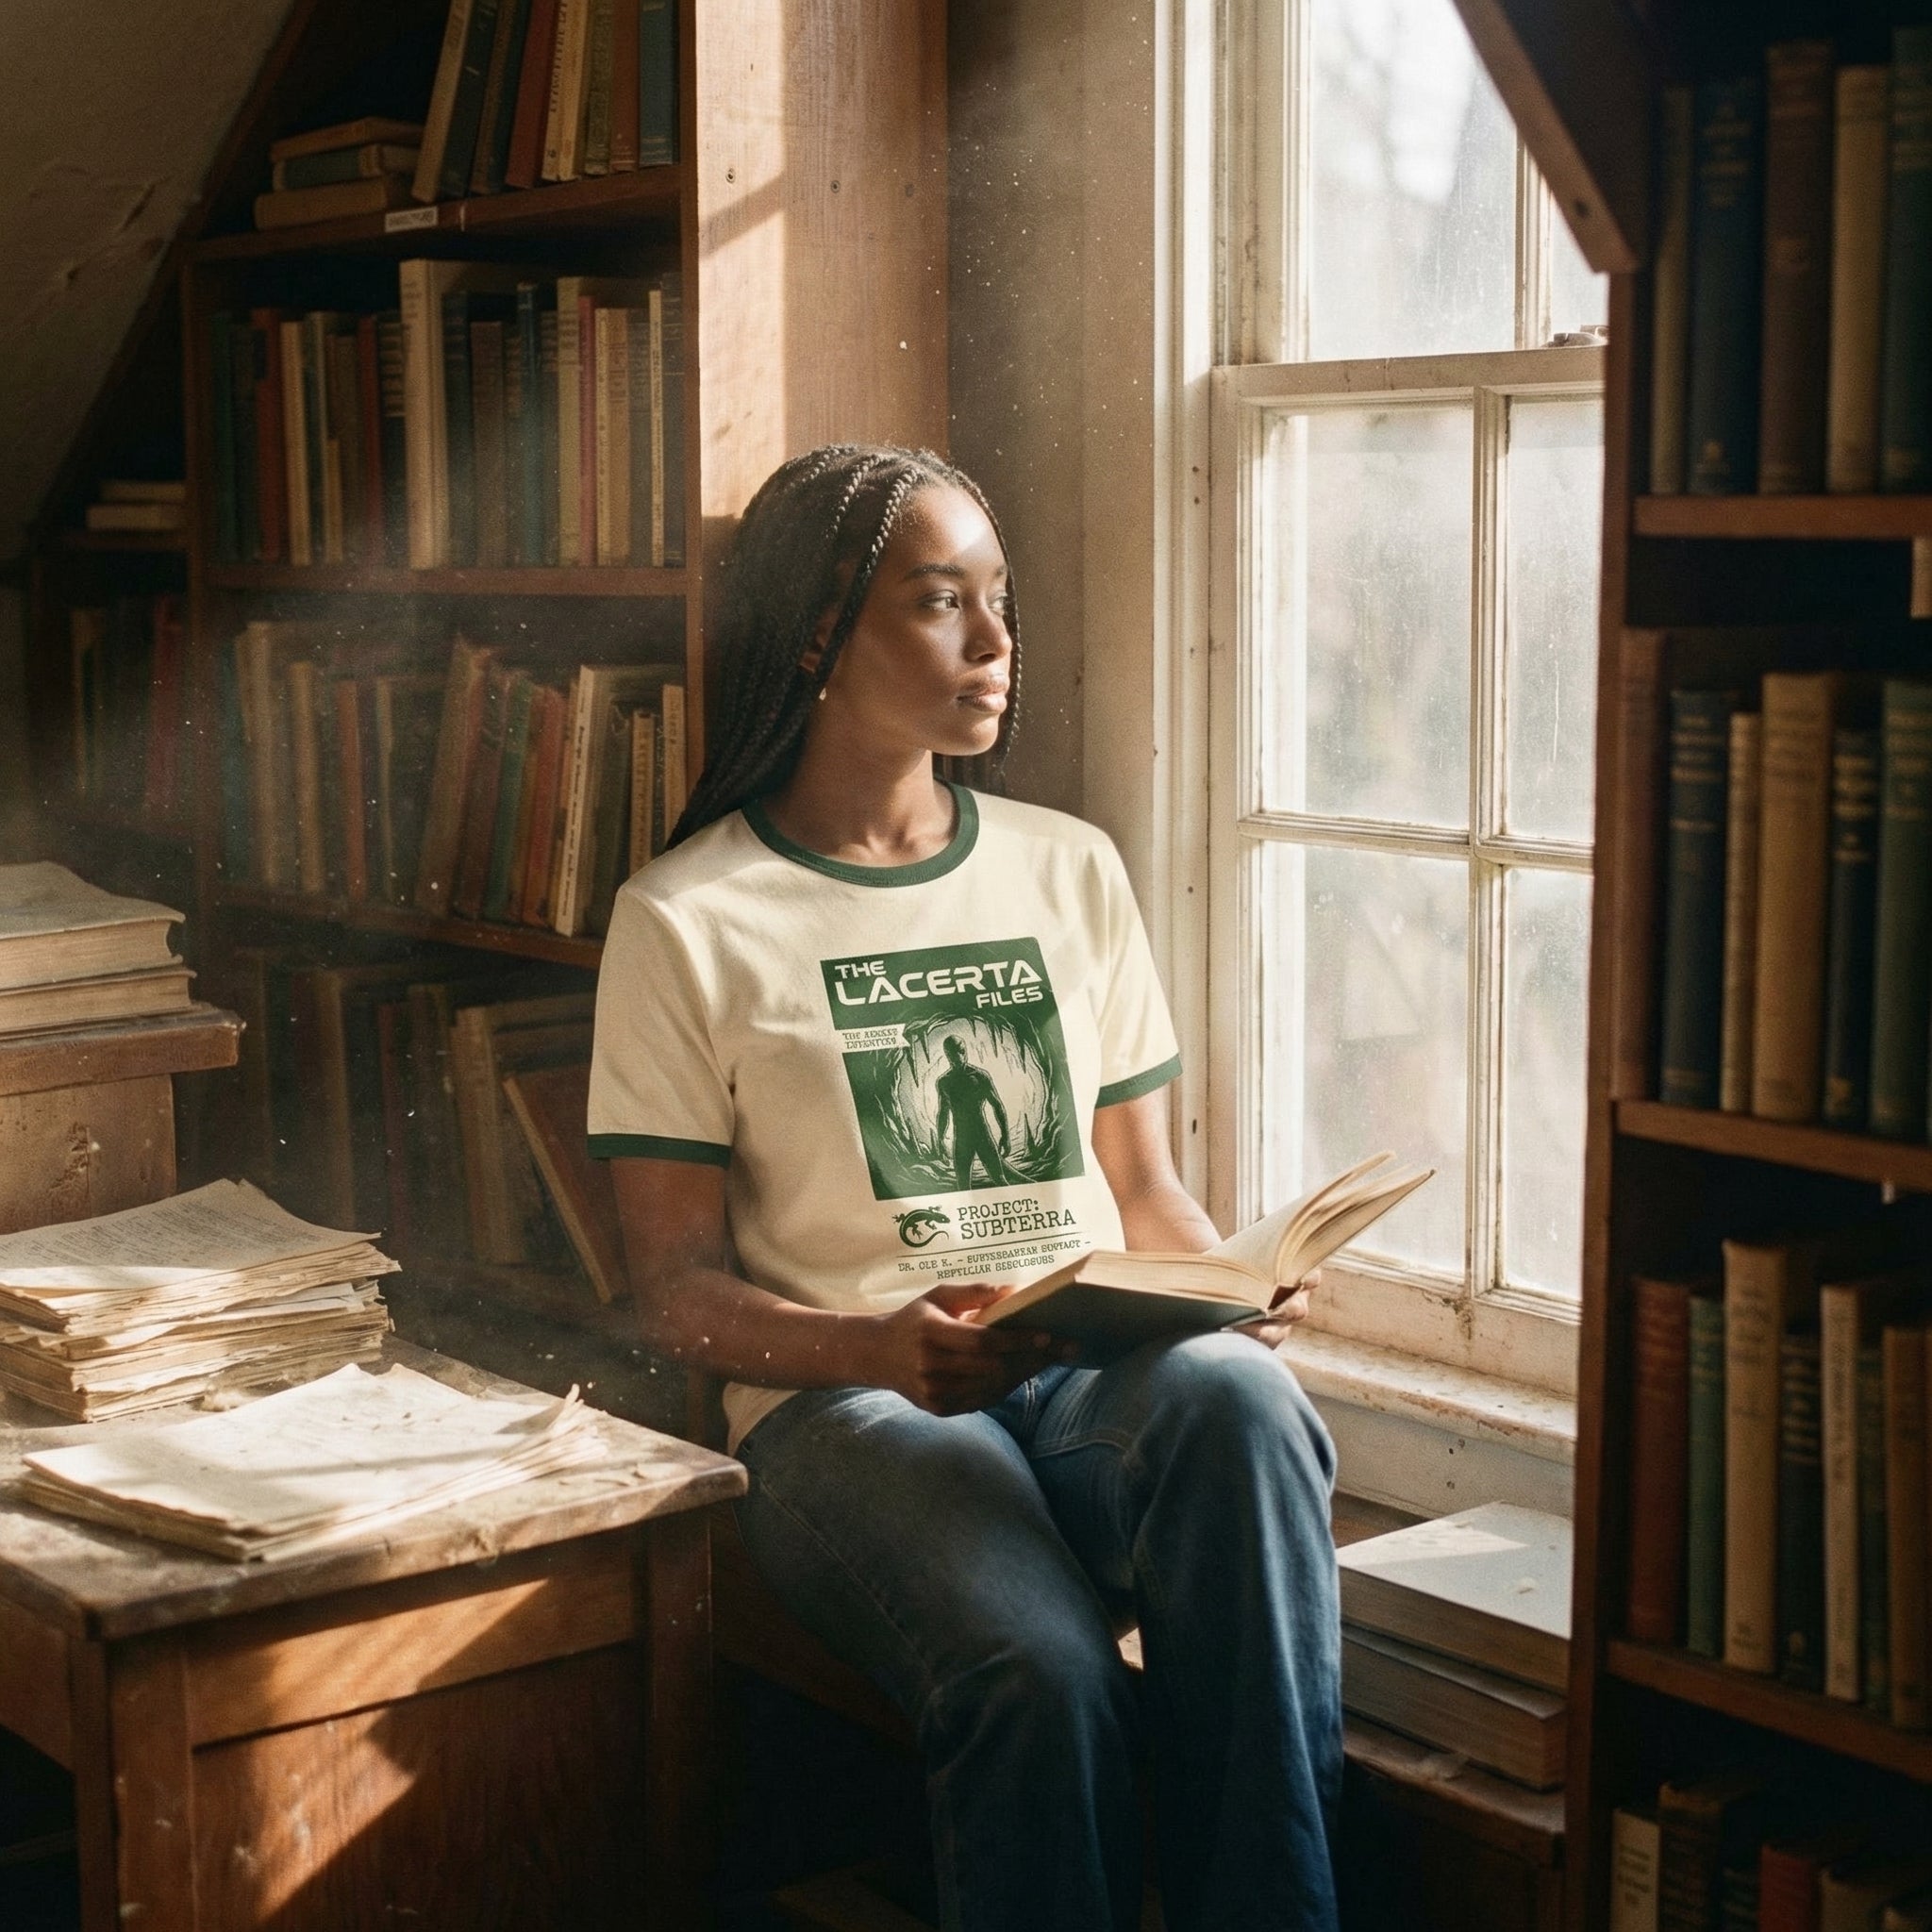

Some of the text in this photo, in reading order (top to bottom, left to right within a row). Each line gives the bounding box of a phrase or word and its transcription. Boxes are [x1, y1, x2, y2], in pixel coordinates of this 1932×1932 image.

[834, 960, 887, 979] THE
[834, 959, 1042, 1006] LACERTA
[975, 986, 1043, 1008] FILES
[957, 1198, 1039, 1221] PROJECT:
[960, 1208, 1076, 1240] SUBTERRA
